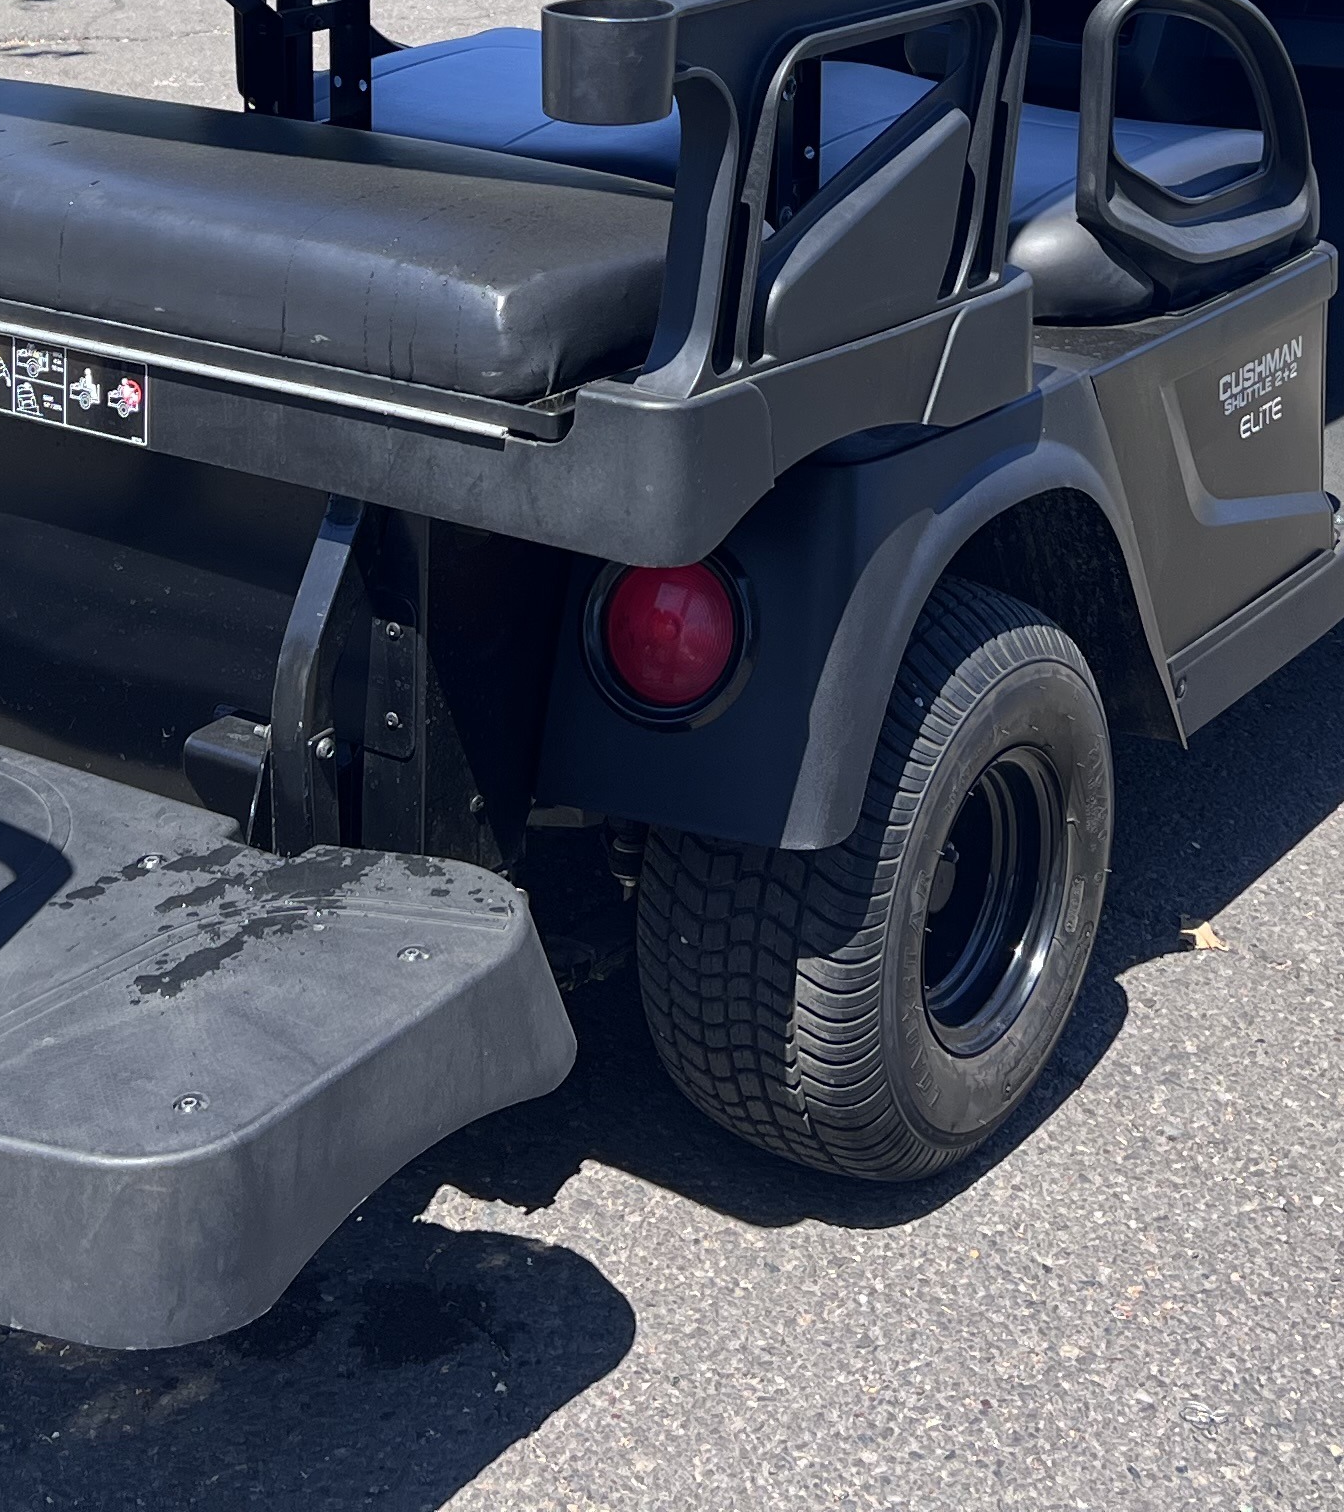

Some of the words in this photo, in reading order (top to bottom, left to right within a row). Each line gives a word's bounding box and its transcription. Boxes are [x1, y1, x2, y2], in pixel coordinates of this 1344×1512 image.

[1219, 335, 1303, 402] CUSHMAN
[1224, 376, 1273, 416] SHUTTLE
[1275, 362, 1298, 387] 2+2
